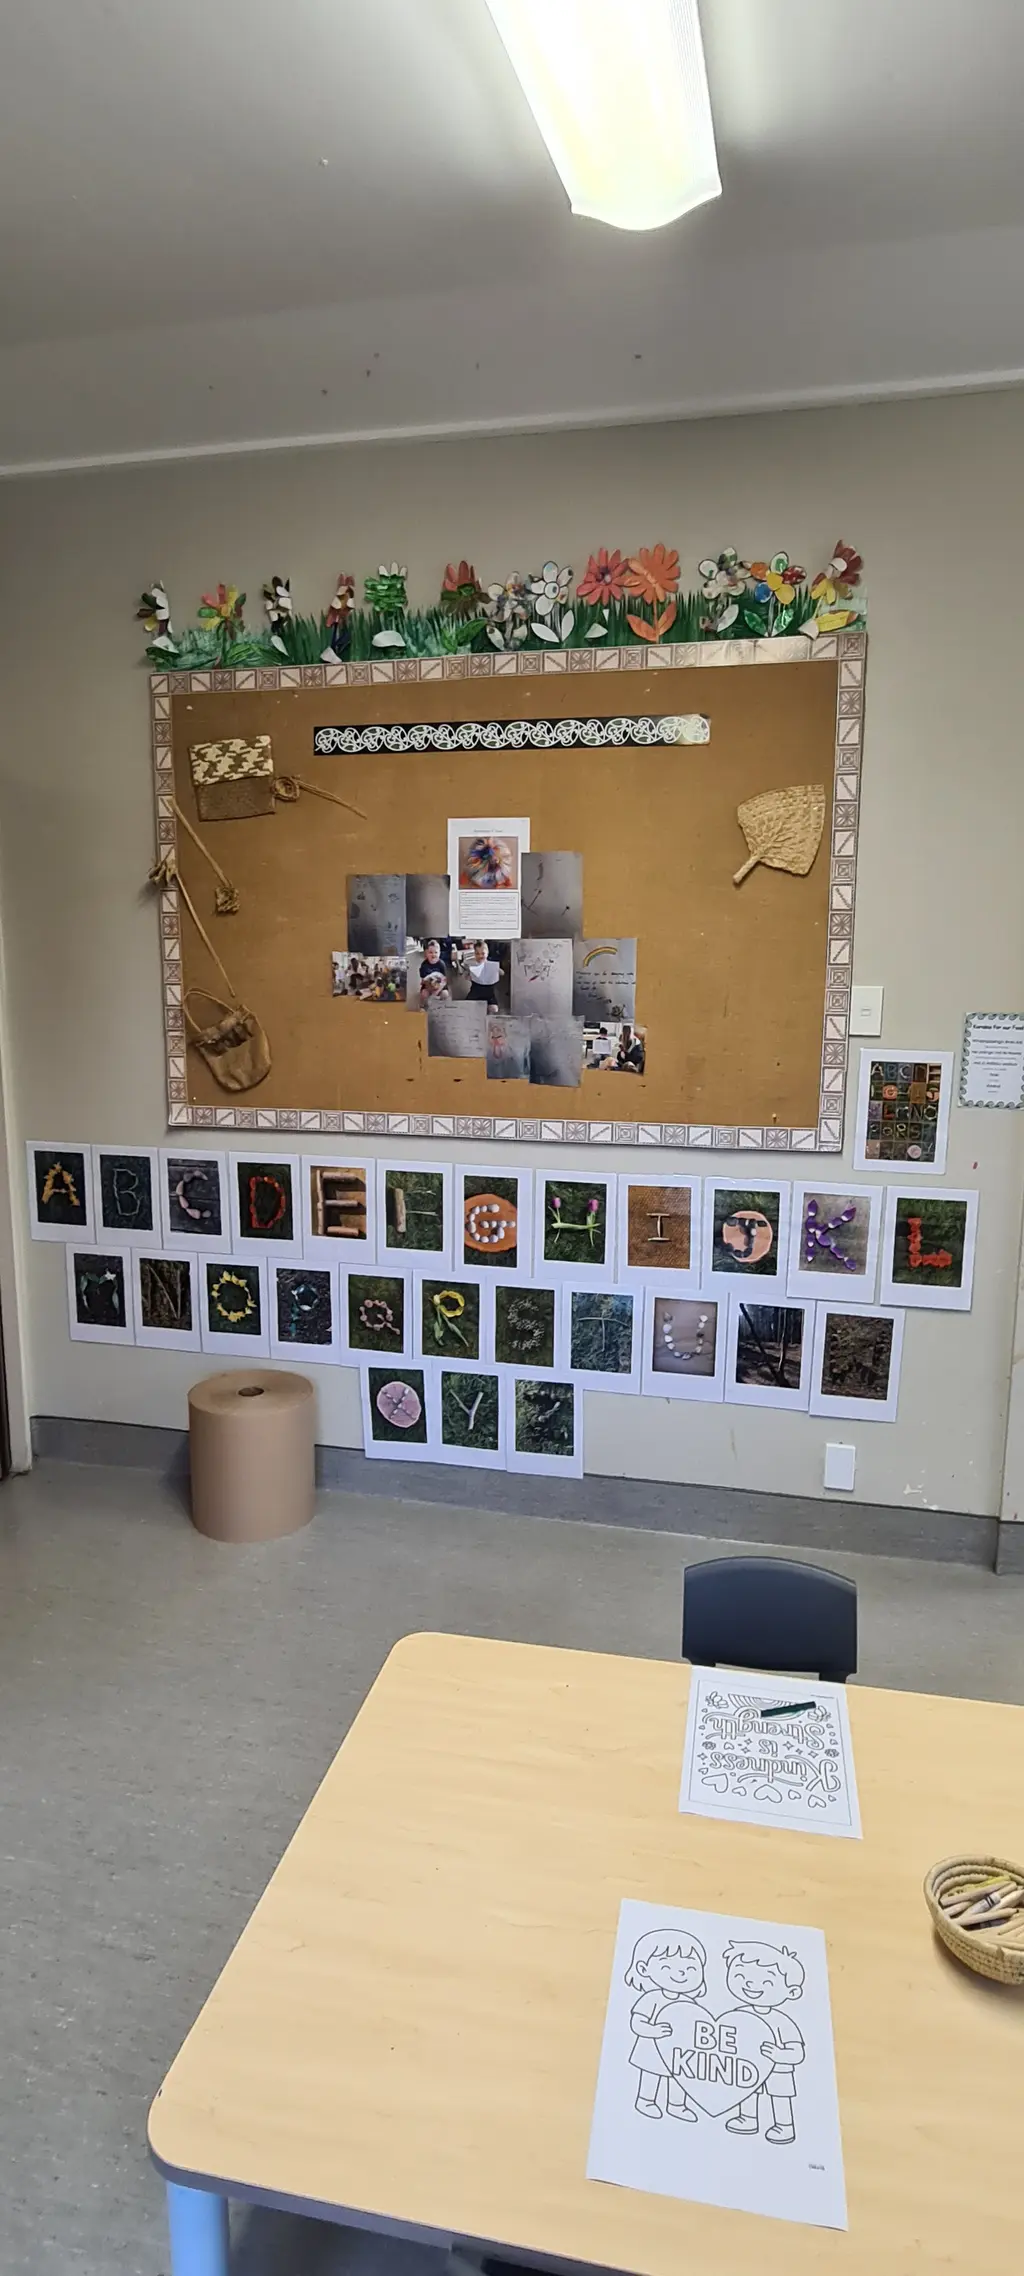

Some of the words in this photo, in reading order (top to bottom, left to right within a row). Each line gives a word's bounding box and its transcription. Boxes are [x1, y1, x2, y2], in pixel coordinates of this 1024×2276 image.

[41, 1162, 80, 1206] A
[113, 1168, 141, 1216] B
[176, 1169, 212, 1219] C
[249, 1175, 286, 1228] D
[316, 1170, 360, 1237] E
[395, 1186, 439, 1233] F
[466, 1203, 516, 1244] G
[548, 1197, 601, 1246] H
[646, 1212, 671, 1242] I
[726, 1216, 767, 1258] J
[806, 1200, 857, 1270] K
[908, 1217, 953, 1268] L
[211, 1270, 257, 1322] O
[289, 1283, 319, 1337] P
[360, 1299, 400, 1335] Q
[429, 1290, 469, 1347] R
[507, 1299, 545, 1350] S
[663, 1311, 708, 1360] U
[450, 1389, 484, 1431] Y
[703, 1706, 825, 1750] Strength
[758, 1738, 778, 1758] is
[710, 1751, 841, 1793] Kindness
[694, 2020, 737, 2055] BE
[672, 2047, 760, 2089] KIND
